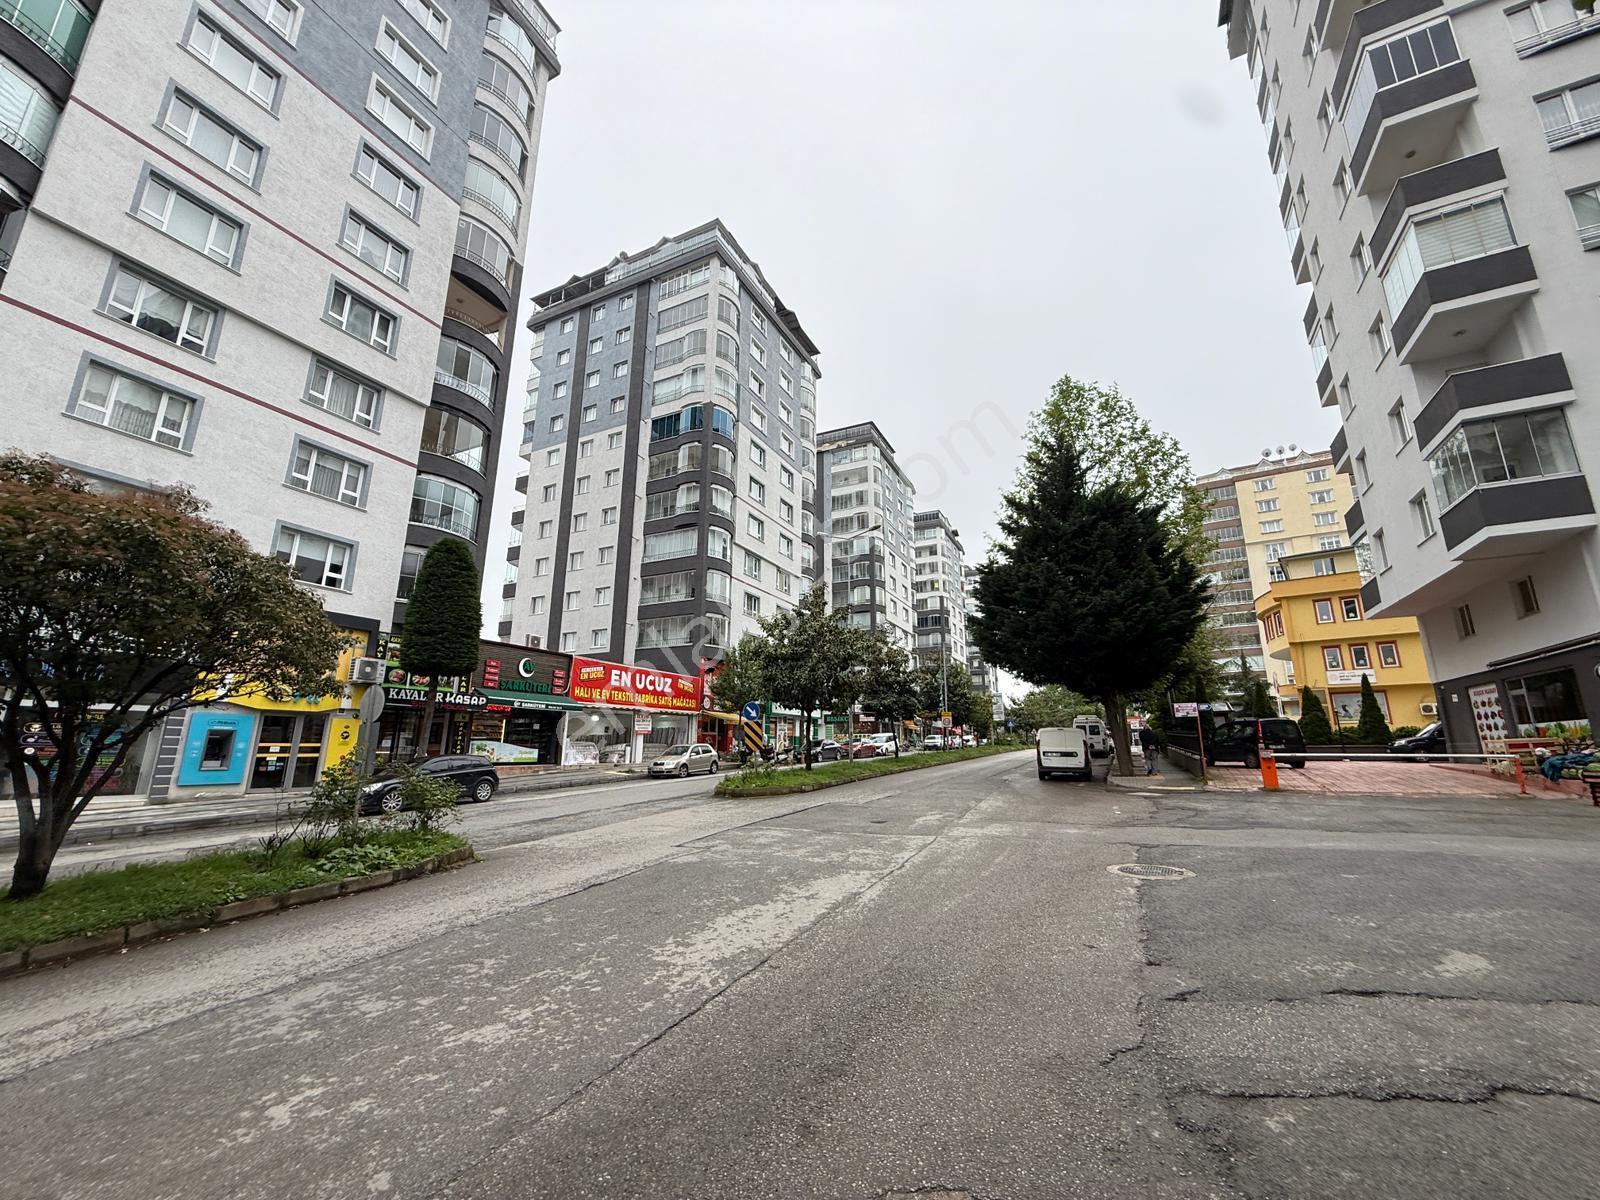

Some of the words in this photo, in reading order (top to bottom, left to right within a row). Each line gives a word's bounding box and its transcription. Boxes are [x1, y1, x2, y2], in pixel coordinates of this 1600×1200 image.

[376, 639, 386, 658] KAY
[580, 672, 589, 680] EN
[611, 669, 631, 687] EN
[635, 673, 673, 693] UCUZ
[388, 688, 444, 702] KAYALR
[445, 692, 487, 706] KASAP
[574, 686, 591, 698] HALI
[591, 688, 601, 699] VE
[601, 689, 611, 700] EV
[611, 690, 634, 702] TEKSTİL
[634, 691, 658, 704] FABRİKA
